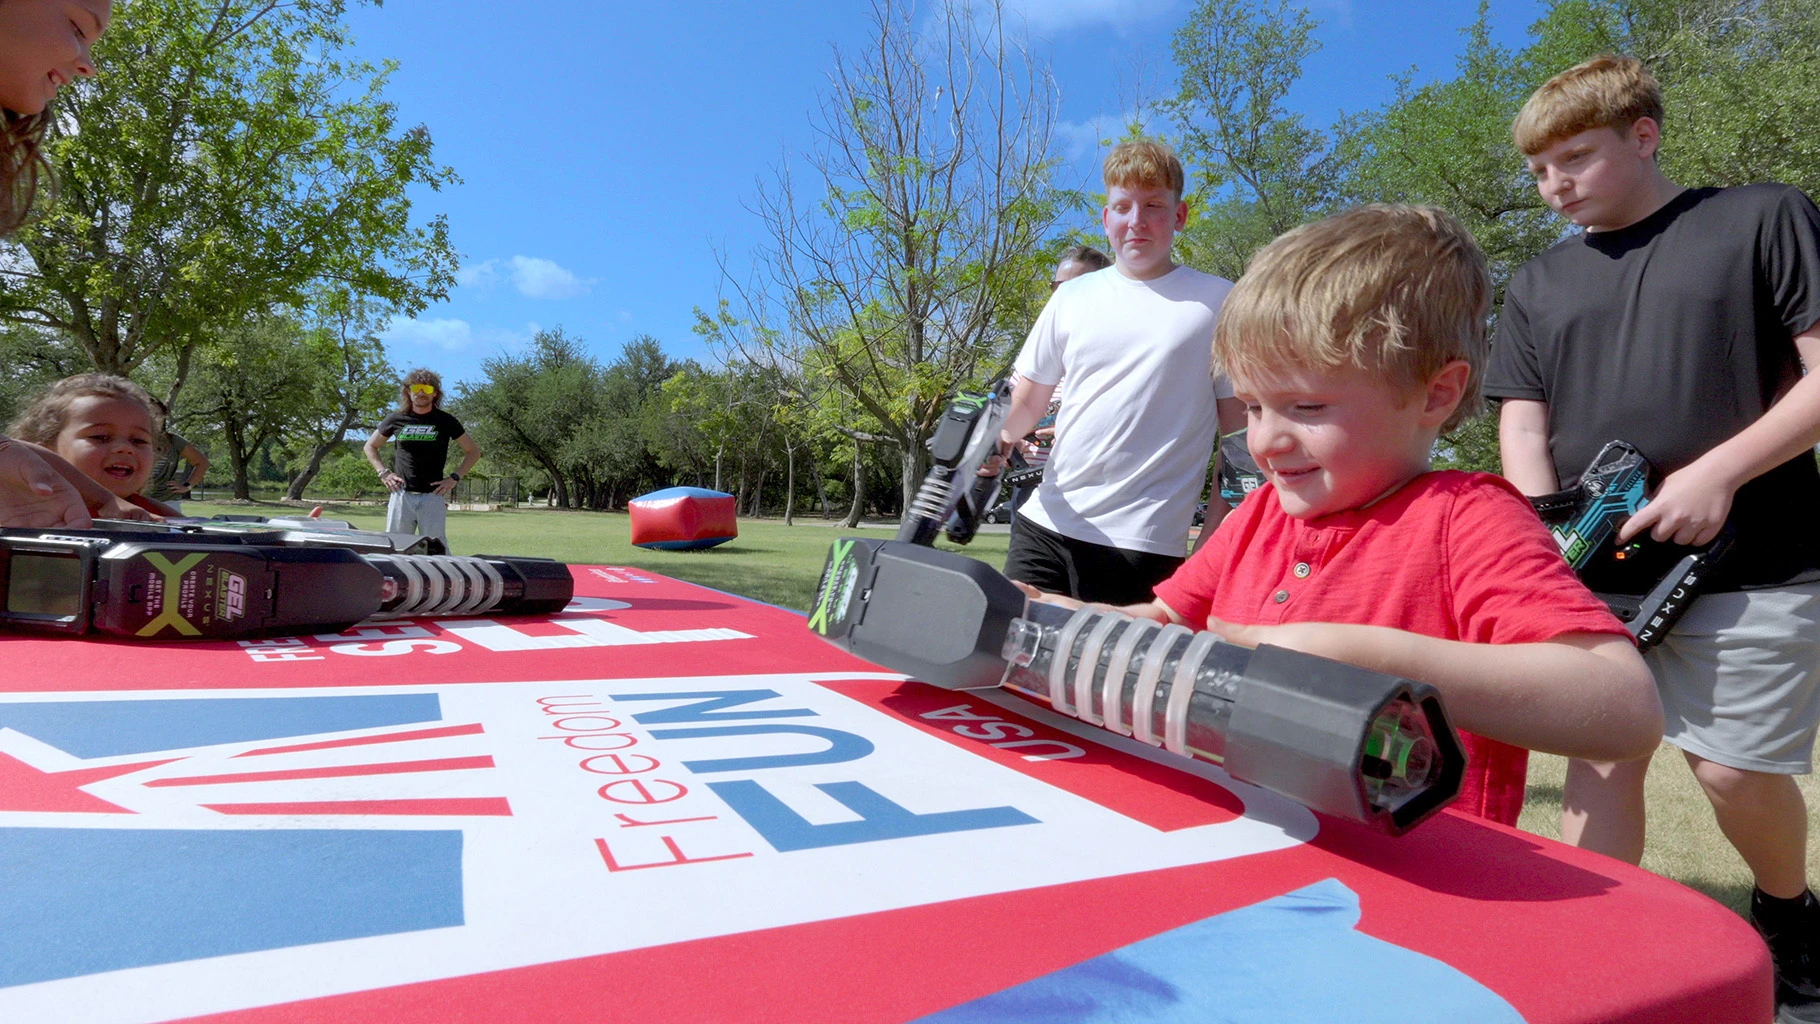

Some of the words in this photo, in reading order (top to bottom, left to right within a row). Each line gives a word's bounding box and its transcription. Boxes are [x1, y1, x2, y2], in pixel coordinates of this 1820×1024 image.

[402, 425, 436, 434] GEL
[1011, 470, 1042, 483] NEXU
[202, 564, 214, 624] NEXUS
[218, 571, 229, 617] BLASTER
[225, 574, 245, 620] GEL
[1639, 573, 1697, 642] NEXUS
[920, 704, 1087, 762] USA
[536, 693, 754, 873] Freedom
[608, 688, 1044, 853] FUN
